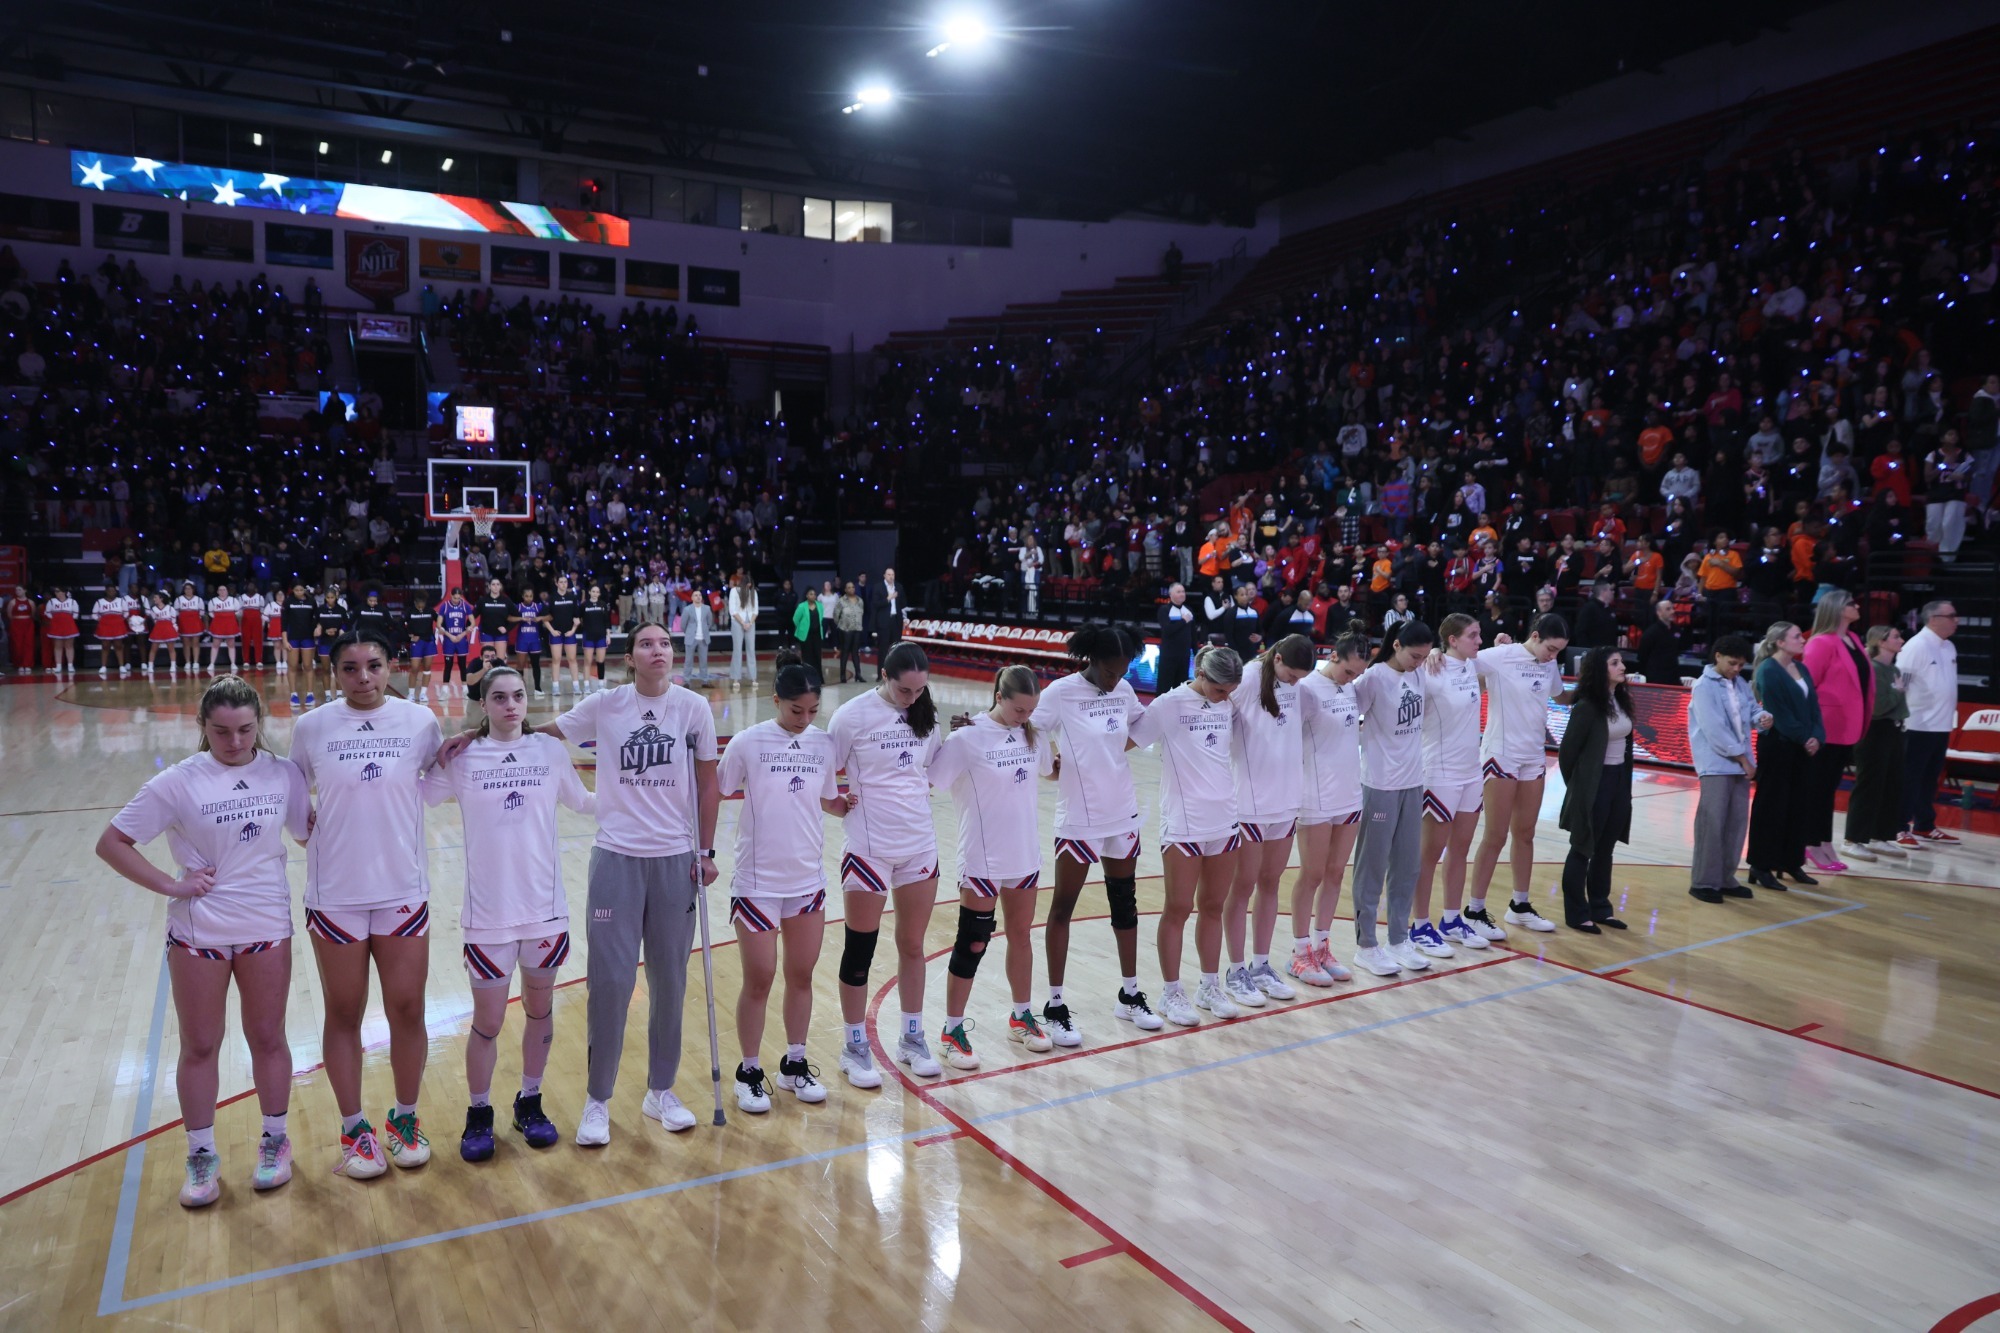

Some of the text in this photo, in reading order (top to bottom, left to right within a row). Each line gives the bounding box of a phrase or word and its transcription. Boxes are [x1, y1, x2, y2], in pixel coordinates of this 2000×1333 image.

[357, 251, 399, 279] NJIT
[1397, 696, 1422, 726] NJIT
[1978, 713, 2000, 725] NJI
[327, 737, 411, 752] HIGHLANDERS
[880, 740, 923, 749] BASKETBALL
[338, 751, 401, 761] BASKETBALL
[620, 737, 676, 775] NJIT
[760, 752, 824, 765] HIGHLANDERS
[997, 757, 1035, 768] BASKETBALL
[360, 766, 382, 781] NJIT
[472, 766, 550, 781] HIGHLANDERS
[771, 765, 819, 773] BASKETBALL
[483, 779, 542, 789] BASKETBALL
[619, 777, 676, 787] BASKETBALL
[201, 794, 285, 815] HIGHLANDERS
[504, 795, 524, 810] NJIT
[216, 807, 279, 824] BASKETBALL
[239, 826, 261, 842] NJIT
[594, 908, 613, 919] NJIT
